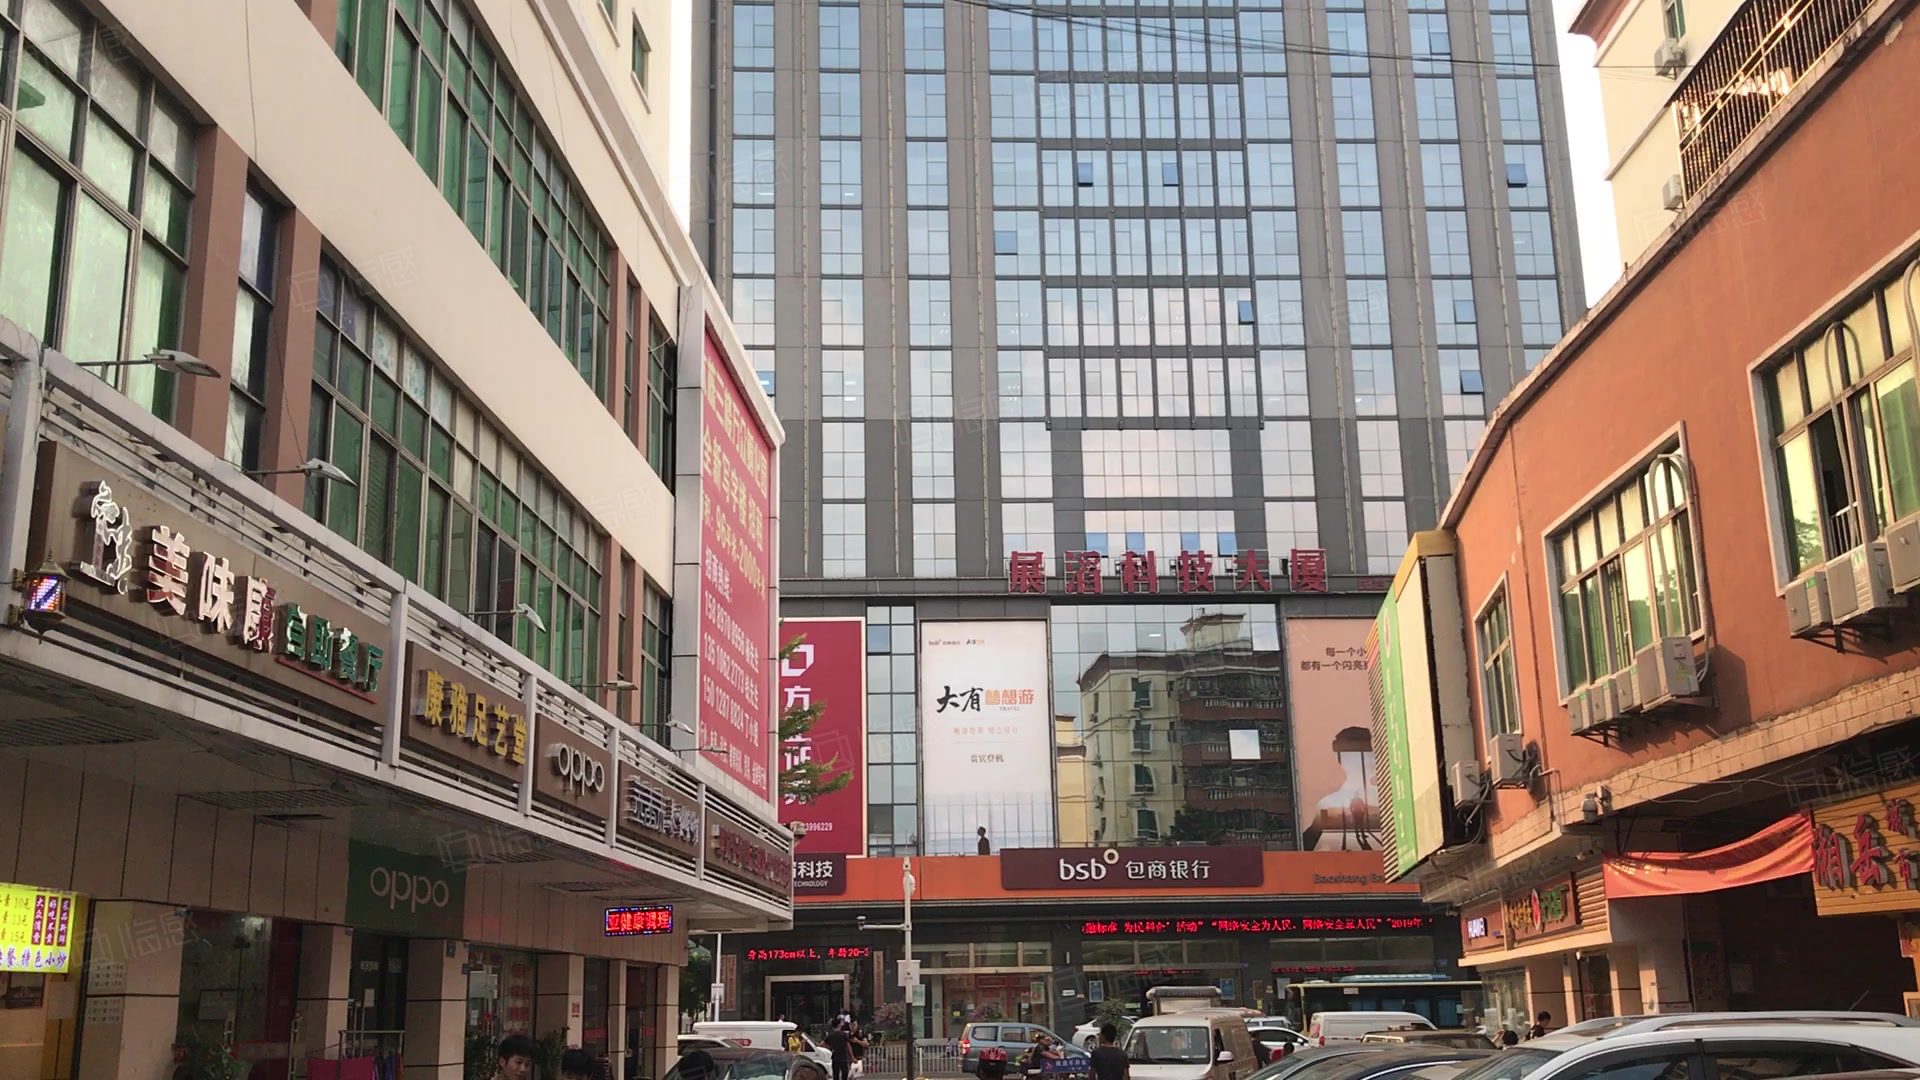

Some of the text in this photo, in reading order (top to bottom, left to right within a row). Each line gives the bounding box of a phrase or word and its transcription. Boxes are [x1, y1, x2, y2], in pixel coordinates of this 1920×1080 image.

[703, 424, 747, 529] 全新写字楼
[749, 494, 763, 552] 招租
[1010, 550, 1328, 593] 展滔科技大厦
[705, 590, 716, 625] 158
[704, 632, 715, 665] 135
[703, 675, 715, 708] 150
[936, 685, 984, 713] 大有
[793, 879, 829, 888] ECHNOLOGY
[1059, 858, 1211, 881] bsb 包商银行
[1313, 873, 1368, 885] Baoshang
[370, 866, 449, 913] oppo
[607, 911, 669, 931] 亚健康调理
